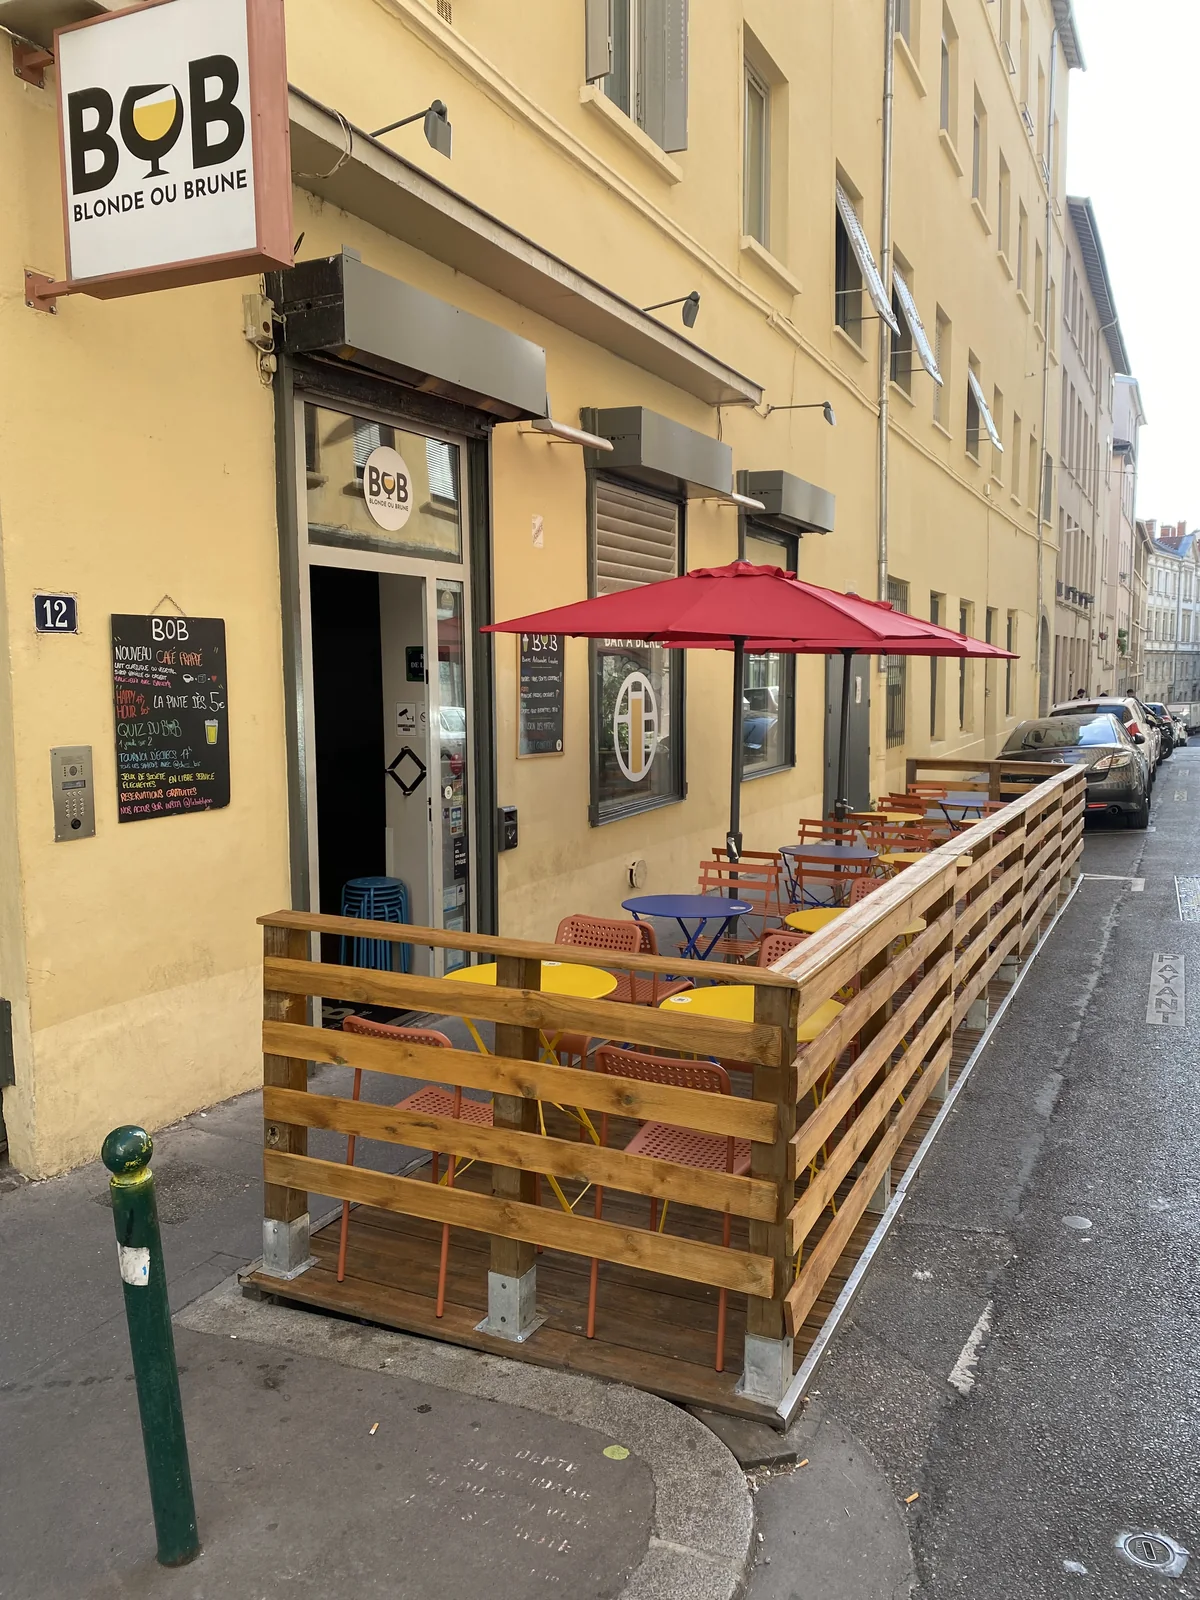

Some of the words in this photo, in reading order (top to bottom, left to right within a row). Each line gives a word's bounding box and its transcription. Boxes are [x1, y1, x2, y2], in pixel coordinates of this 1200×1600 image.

[73, 191, 145, 222] BLONDE
[150, 184, 177, 206] OU
[184, 169, 247, 200] BRUNE
[369, 498, 387, 508] BLONDE
[395, 503, 409, 511] BRUNE
[43, 600, 68, 628] 12
[152, 618, 189, 641] BOB
[115, 645, 152, 661] NOUVEAU
[156, 646, 176, 665] CAFÉ
[116, 690, 136, 704] HAPPY
[153, 695, 164, 709] LA
[166, 695, 188, 709] PINTE
[192, 692, 207, 710] DÈS
[116, 704, 137, 719] HOUR
[117, 722, 146, 739] QUIZ
[147, 721, 160, 735] DU
[147, 736, 153, 746] 2
[120, 773, 136, 781] JEUX
[138, 773, 145, 781] DE
[168, 775, 176, 784] EN
[178, 773, 193, 781] LIBRE
[151, 801, 165, 810] SUR
[1156, 954, 1179, 1024] PAYANT
